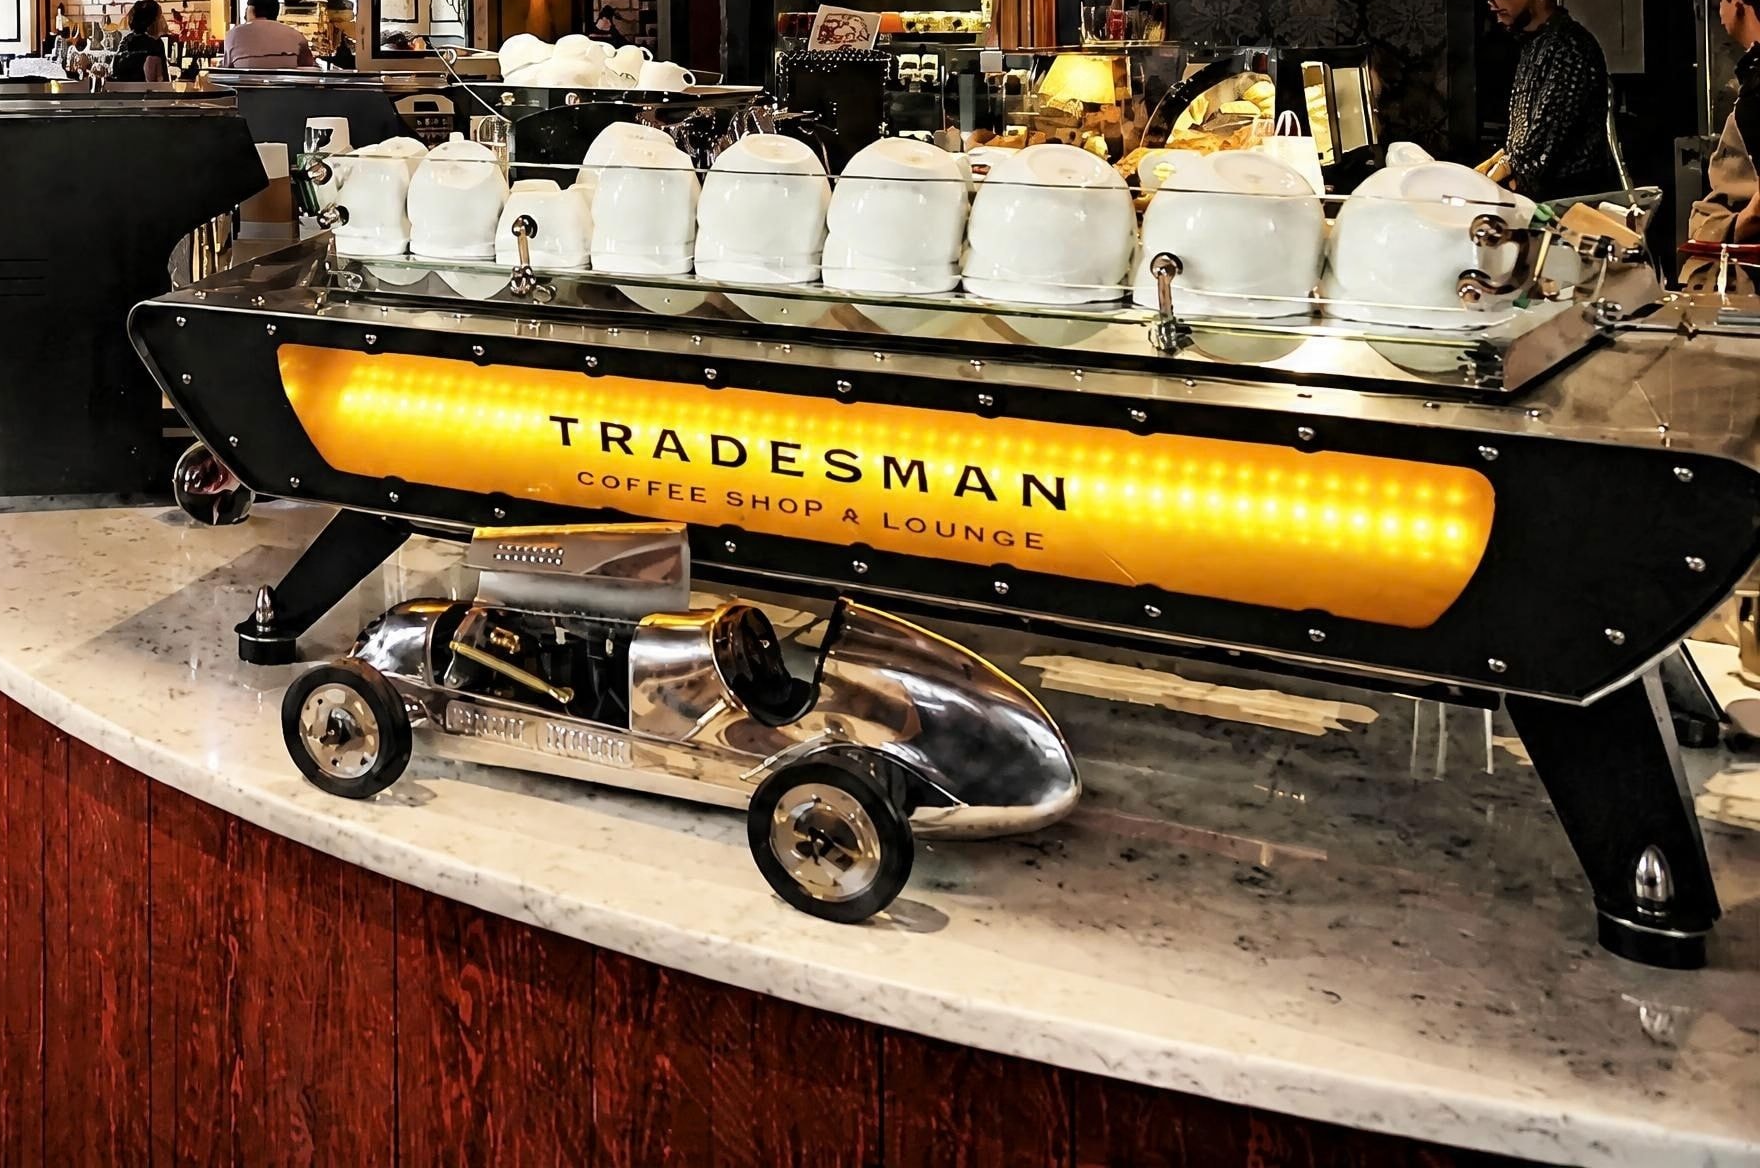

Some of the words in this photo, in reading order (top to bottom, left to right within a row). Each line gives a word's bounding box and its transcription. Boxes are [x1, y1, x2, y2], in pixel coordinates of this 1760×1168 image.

[549, 415, 1068, 512] TRADESMAN
[577, 471, 707, 503] COFFEE
[726, 491, 823, 517] SHOP
[883, 512, 1044, 550] LOUNGE
